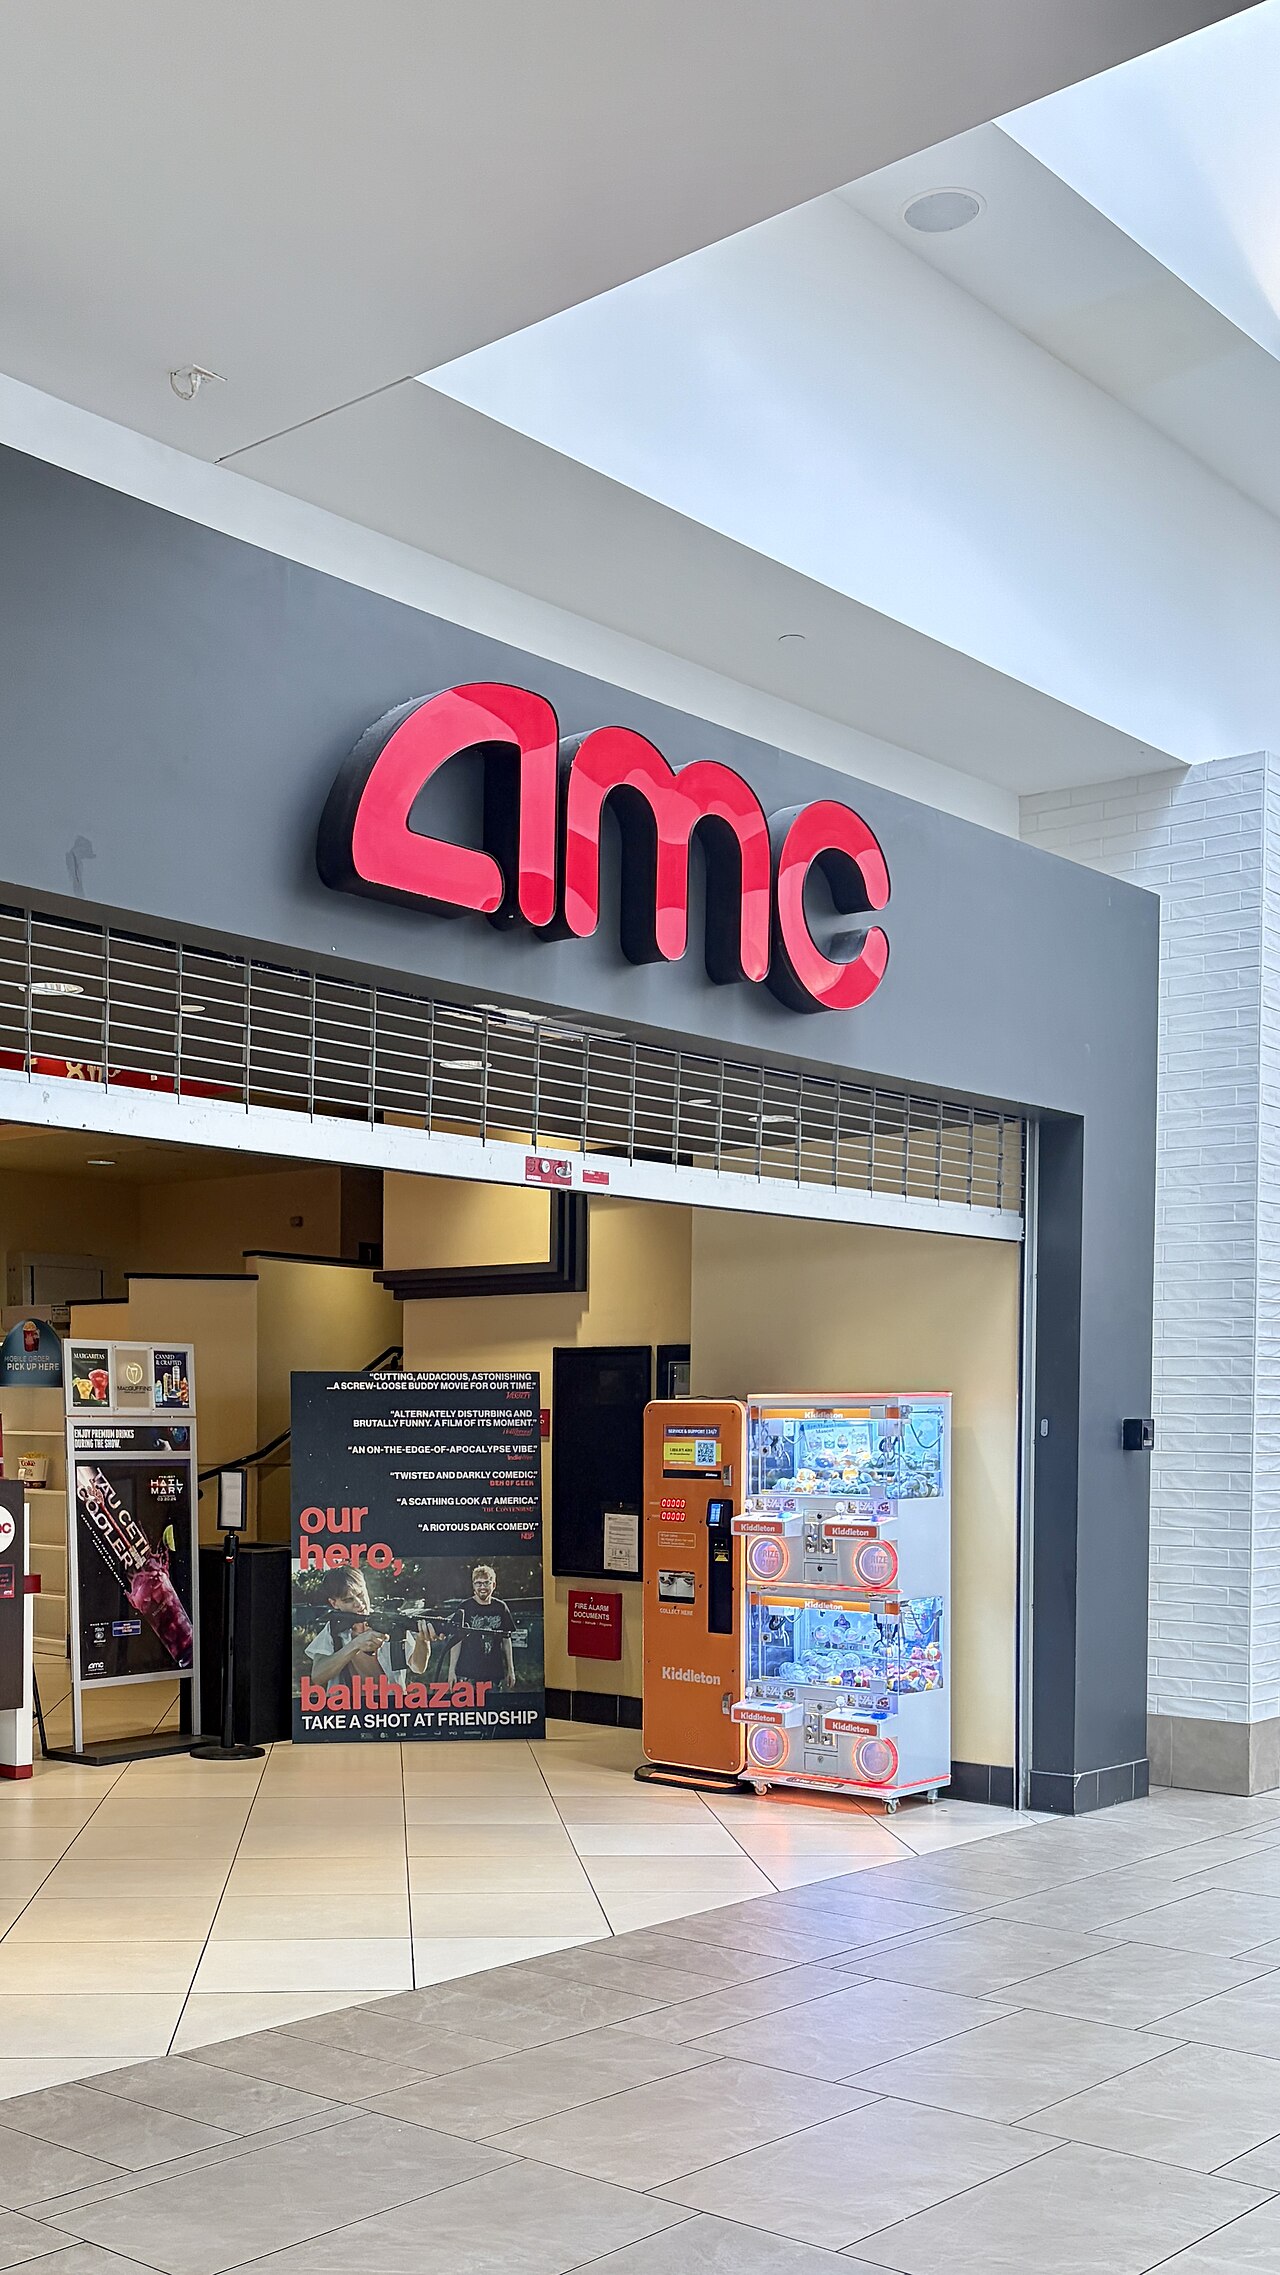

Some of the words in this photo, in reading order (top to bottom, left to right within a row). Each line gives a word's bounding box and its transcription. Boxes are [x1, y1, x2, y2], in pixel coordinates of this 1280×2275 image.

[325, 682, 891, 1013] amc
[7, 1363, 25, 1371] PICK
[26, 1363, 37, 1371] UP
[38, 1363, 60, 1371] HERE
[416, 1373, 470, 1381] AUDACIOUS,
[471, 1373, 532, 1381] ASTONISHING
[341, 1382, 408, 1390] SCREW-LOOSE
[409, 1382, 439, 1390] BUDDY
[440, 1382, 470, 1390] MOVIE
[470, 1382, 488, 1390] FOR
[489, 1382, 509, 1390] OUR
[458, 1410, 513, 1418] DISTURBING
[513, 1410, 533, 1418] AND
[353, 1419, 399, 1428] BRUTALLY
[400, 1419, 432, 1428] FUNNY.
[434, 1419, 441, 1428] A
[441, 1419, 463, 1428] FILM
[463, 1419, 476, 1428] OF
[477, 1419, 492, 1428] ITS
[75, 1429, 91, 1439] ENJOY
[91, 1429, 115, 1439] PREMIUM
[115, 1429, 135, 1439] DRINKS
[75, 1439, 94, 1448] DURING
[94, 1439, 105, 1448] THE
[367, 1445, 511, 1454] ON-THE-EDGE-OF-APOCALYPSE
[436, 1471, 456, 1480] AND
[457, 1471, 491, 1480] DARKLY
[150, 1479, 184, 1487] HAIL
[150, 1487, 183, 1495] MARY
[409, 1496, 454, 1505] SCATHING
[455, 1496, 480, 1505] LOOK
[481, 1496, 493, 1505] AT
[95, 1467, 121, 1509] TAU
[118, 1510, 151, 1556] CETI
[299, 1506, 369, 1533] our
[77, 1486, 134, 1570] COOLER
[430, 1522, 470, 1531] RIOTOUS
[470, 1522, 496, 1531] DARK
[740, 1523, 776, 1533] Kiddleton
[831, 1527, 869, 1537] Kiddleton
[299, 1536, 403, 1576] hero,
[574, 1602, 588, 1610] FIRE
[588, 1604, 609, 1612] ALARM
[804, 1601, 844, 1611] Kiddleton
[573, 1611, 610, 1621] DOCUMENTS
[660, 1608, 681, 1616] COLLECT
[662, 1666, 721, 1686] Kiddleton
[300, 1675, 492, 1712] balthazar
[302, 1714, 346, 1730] TAKE
[349, 1714, 361, 1729] A
[363, 1713, 411, 1729] SHOT
[414, 1712, 434, 1728] AT
[438, 1711, 538, 1727] FRIENDSHIP
[740, 1711, 776, 1723] Kiddleton
[832, 1721, 870, 1734] Kiddleton
